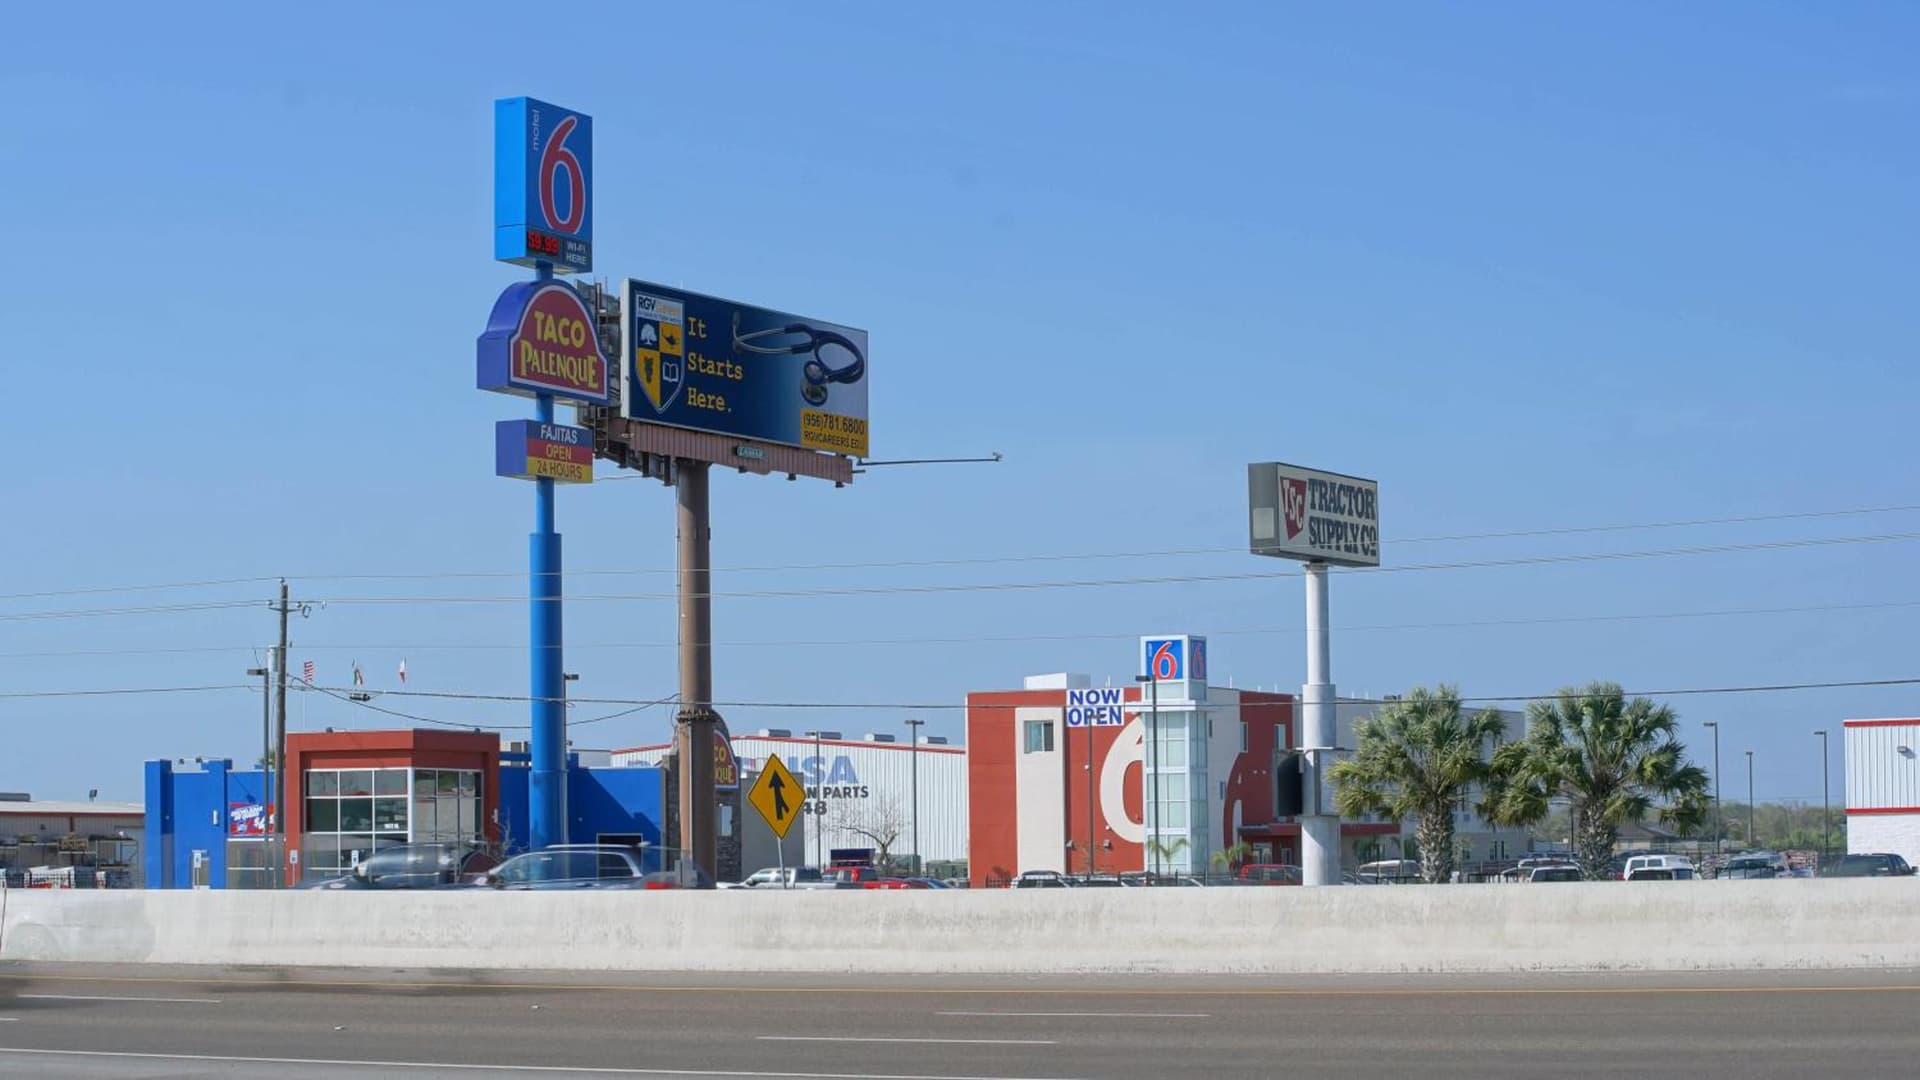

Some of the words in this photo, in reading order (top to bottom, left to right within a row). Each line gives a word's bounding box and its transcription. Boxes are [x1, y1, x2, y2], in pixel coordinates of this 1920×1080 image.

[539, 115, 585, 235] 6
[566, 252, 587, 265] HERE
[638, 295, 656, 311] RGV
[534, 310, 586, 348] TACO
[687, 317, 707, 338] It
[519, 339, 599, 389] PALENQUE
[687, 351, 744, 380] Starts
[687, 387, 732, 413] Here.
[540, 424, 578, 444] FAJITAS
[546, 443, 572, 460] OPEN
[536, 459, 546, 474] 24
[551, 462, 582, 480] HOURS
[1282, 479, 1303, 529] TSC
[1308, 478, 1376, 520] TRACTOR
[1309, 516, 1358, 554] SUPPLY
[1152, 641, 1178, 681] 6
[1069, 690, 1120, 705] NOW
[1068, 706, 1122, 726] OPEN
[823, 786, 869, 799] PARTS
